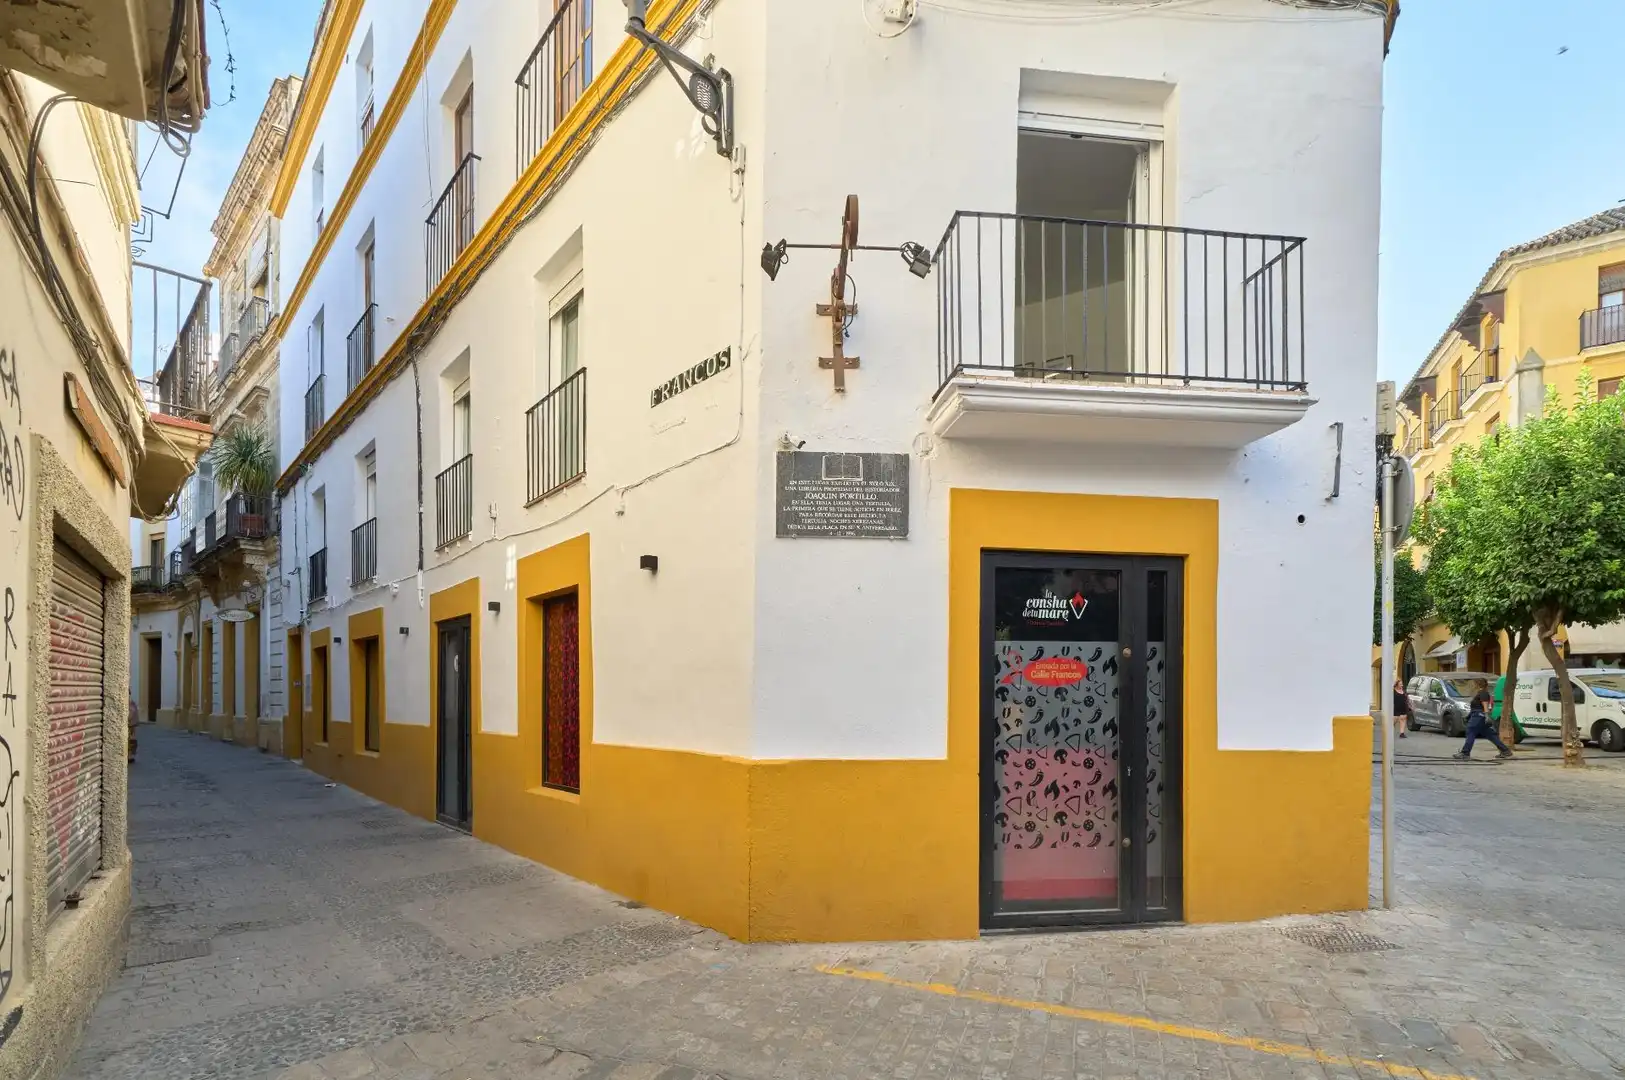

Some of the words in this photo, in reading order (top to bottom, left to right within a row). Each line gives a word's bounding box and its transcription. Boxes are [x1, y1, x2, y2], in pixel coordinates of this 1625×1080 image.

[651, 345, 731, 408] FRANCOS
[1026, 596, 1067, 608] consha
[1036, 661, 1058, 669] Entrada
